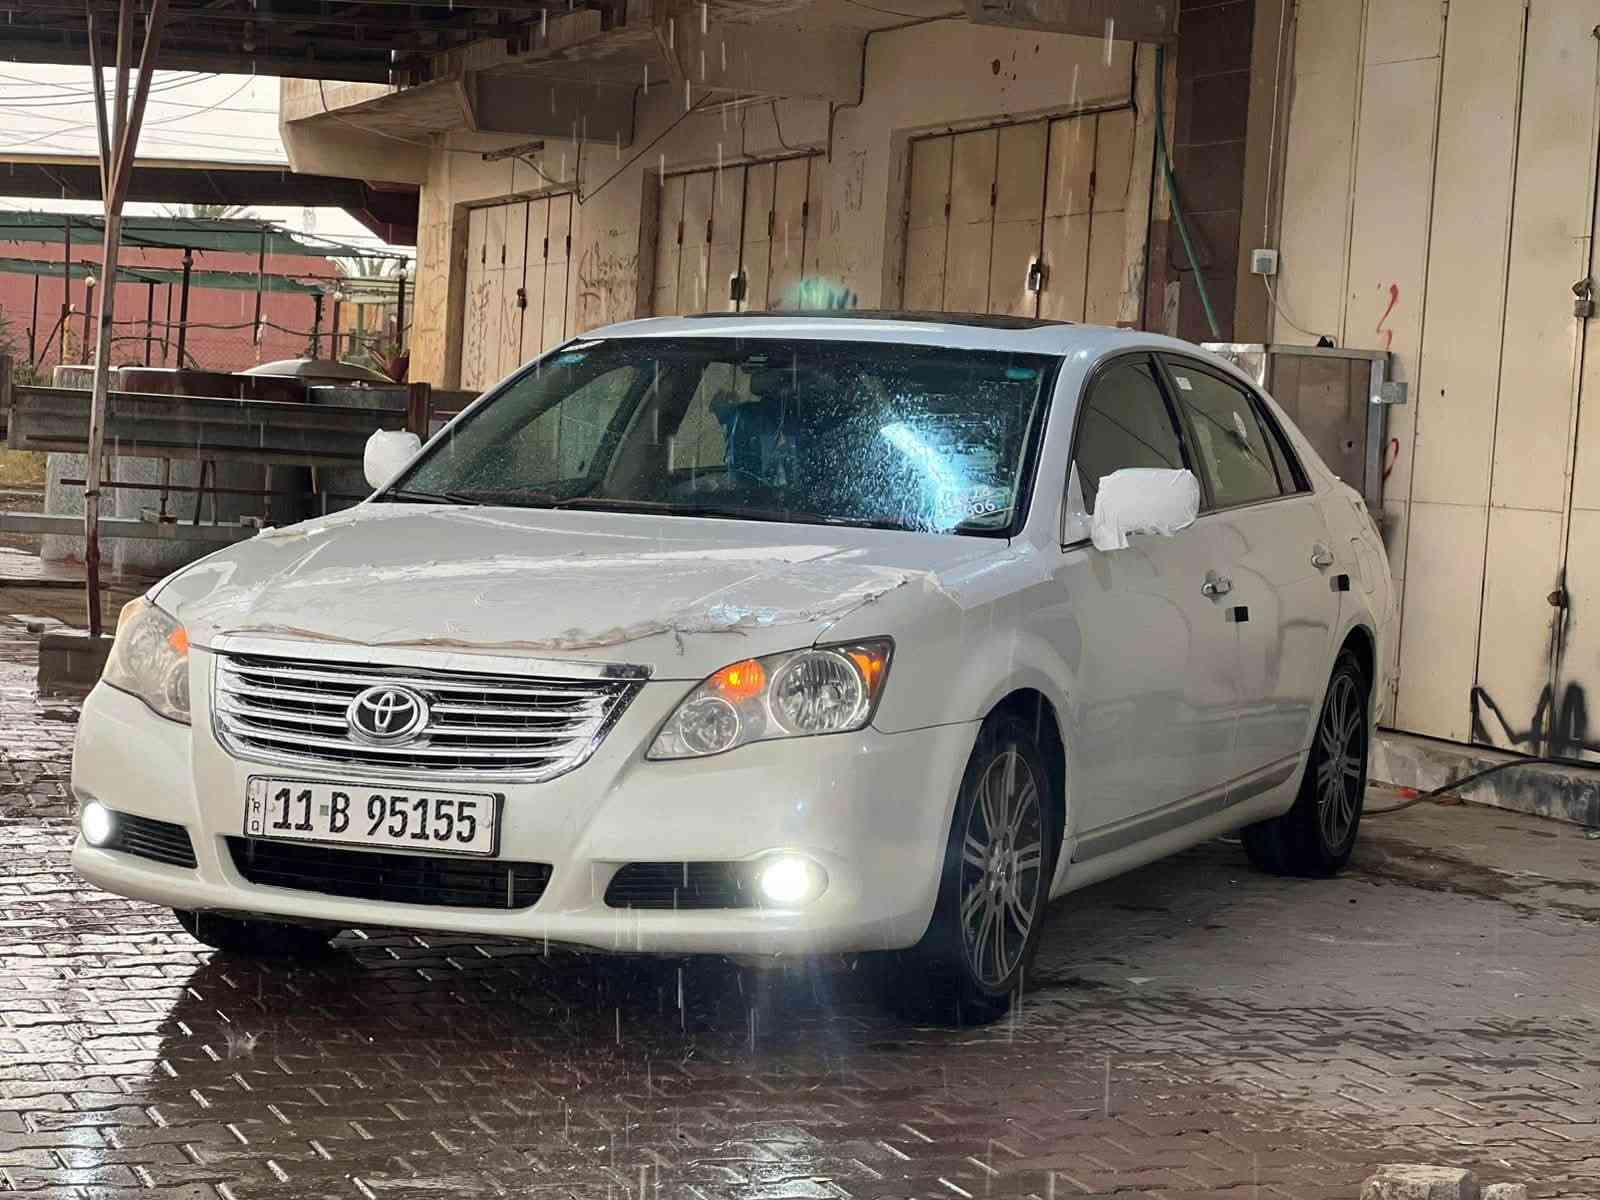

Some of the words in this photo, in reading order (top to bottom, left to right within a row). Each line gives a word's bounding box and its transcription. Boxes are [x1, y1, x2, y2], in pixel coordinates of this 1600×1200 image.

[272, 787, 314, 832] 11
[328, 791, 351, 834] B
[366, 794, 477, 843] 95155
